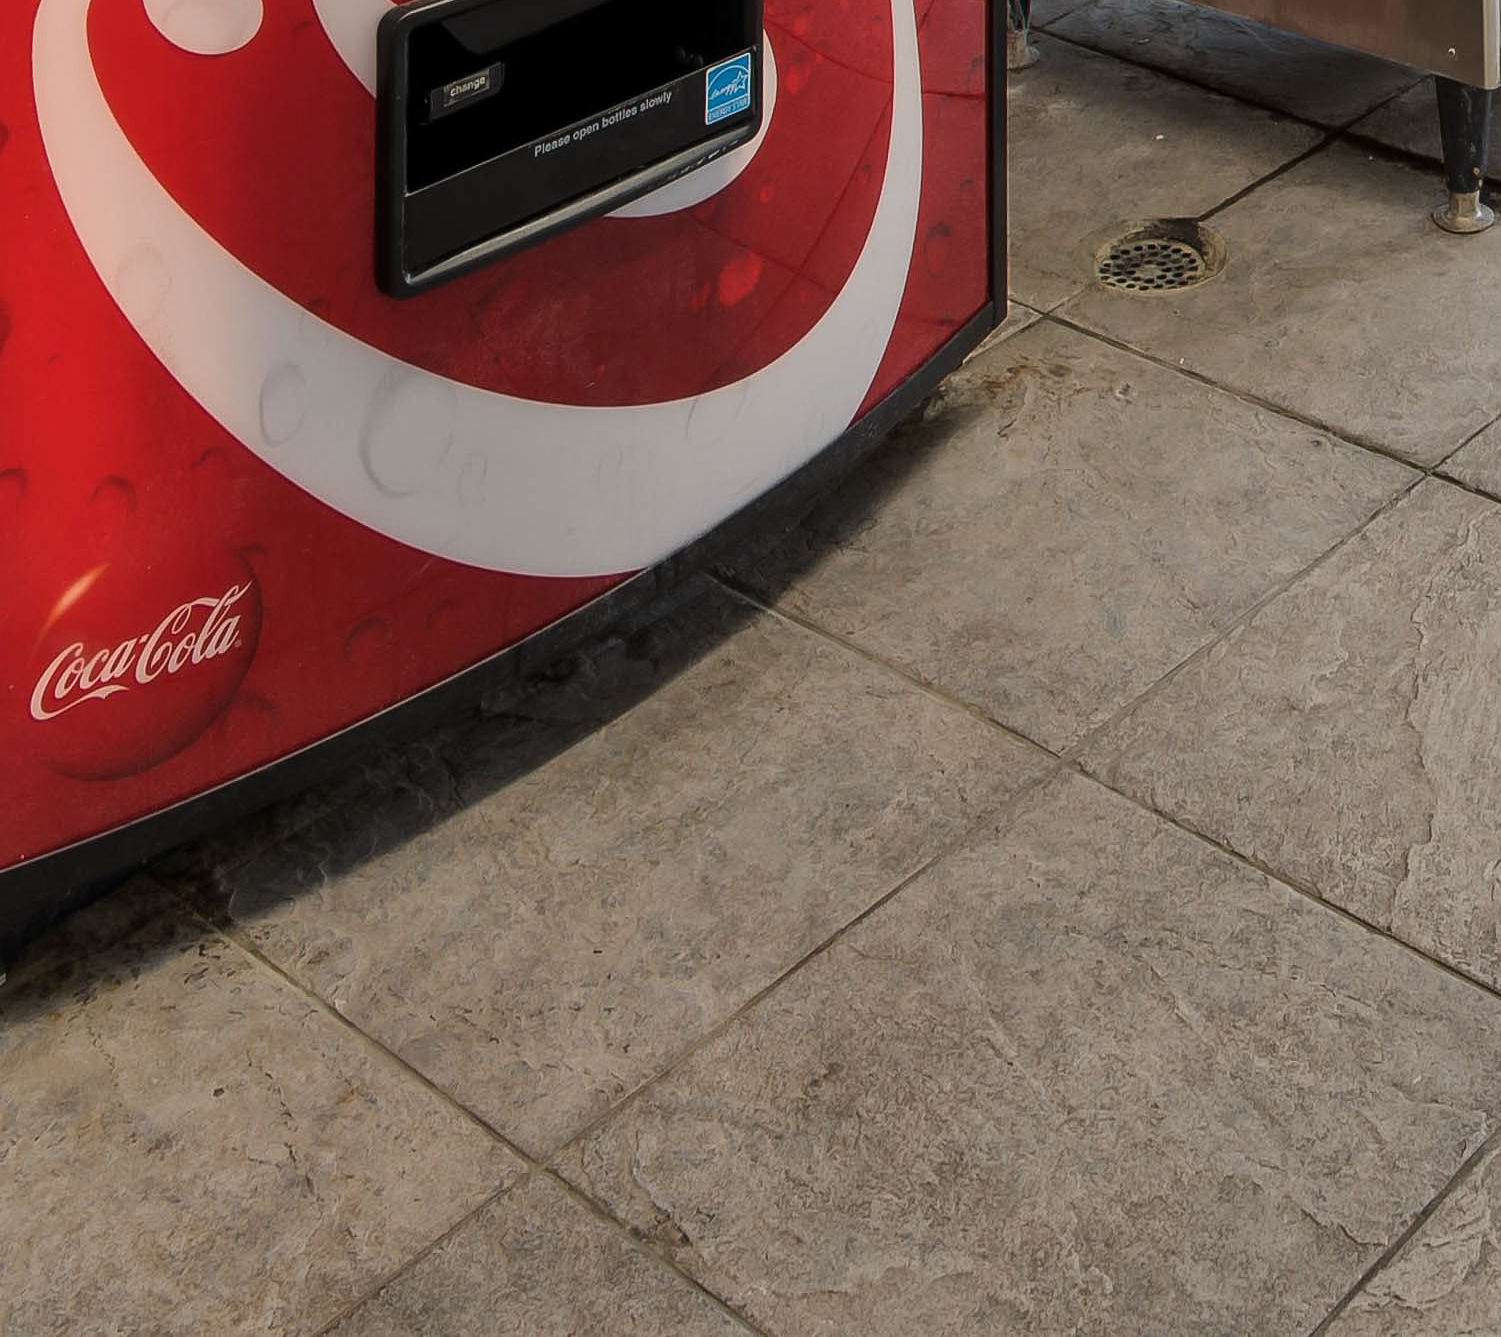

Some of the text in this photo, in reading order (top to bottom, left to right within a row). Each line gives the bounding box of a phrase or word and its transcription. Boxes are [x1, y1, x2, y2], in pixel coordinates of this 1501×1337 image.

[450, 75, 486, 97] change
[534, 90, 672, 157] Please open bottles slowly
[30, 580, 253, 721] Coca-Cola
